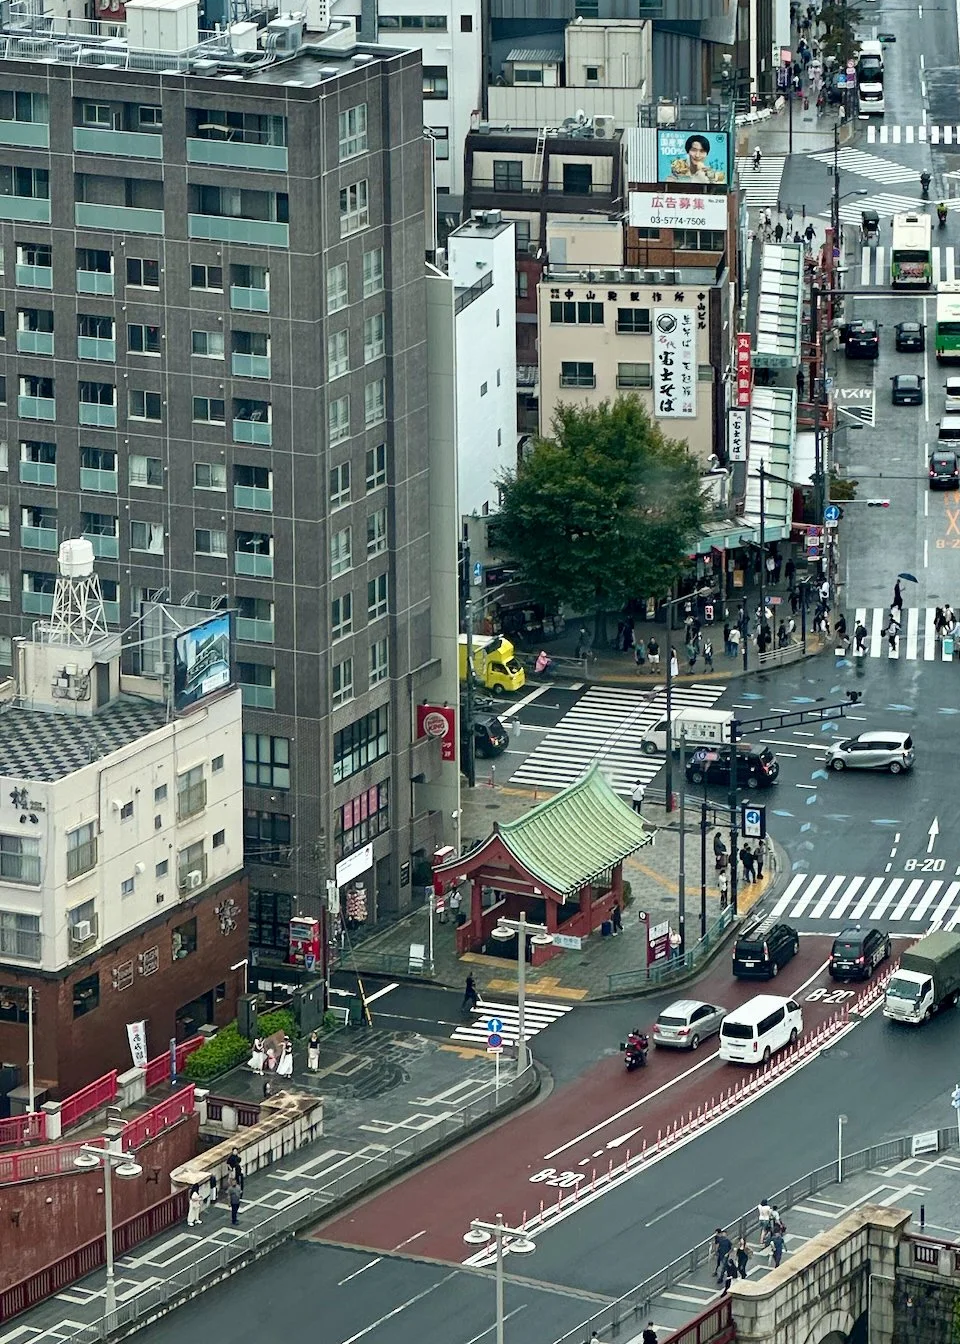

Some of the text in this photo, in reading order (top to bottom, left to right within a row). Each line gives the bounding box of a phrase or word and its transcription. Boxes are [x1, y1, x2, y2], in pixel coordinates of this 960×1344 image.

[651, 196, 706, 210] 広告募集
[650, 216, 706, 227] 03-5774-7506
[834, 388, 873, 399] バス停
[904, 858, 946, 872] 8-20
[804, 987, 856, 1004] 8-20
[529, 1168, 586, 1188] 8-20
